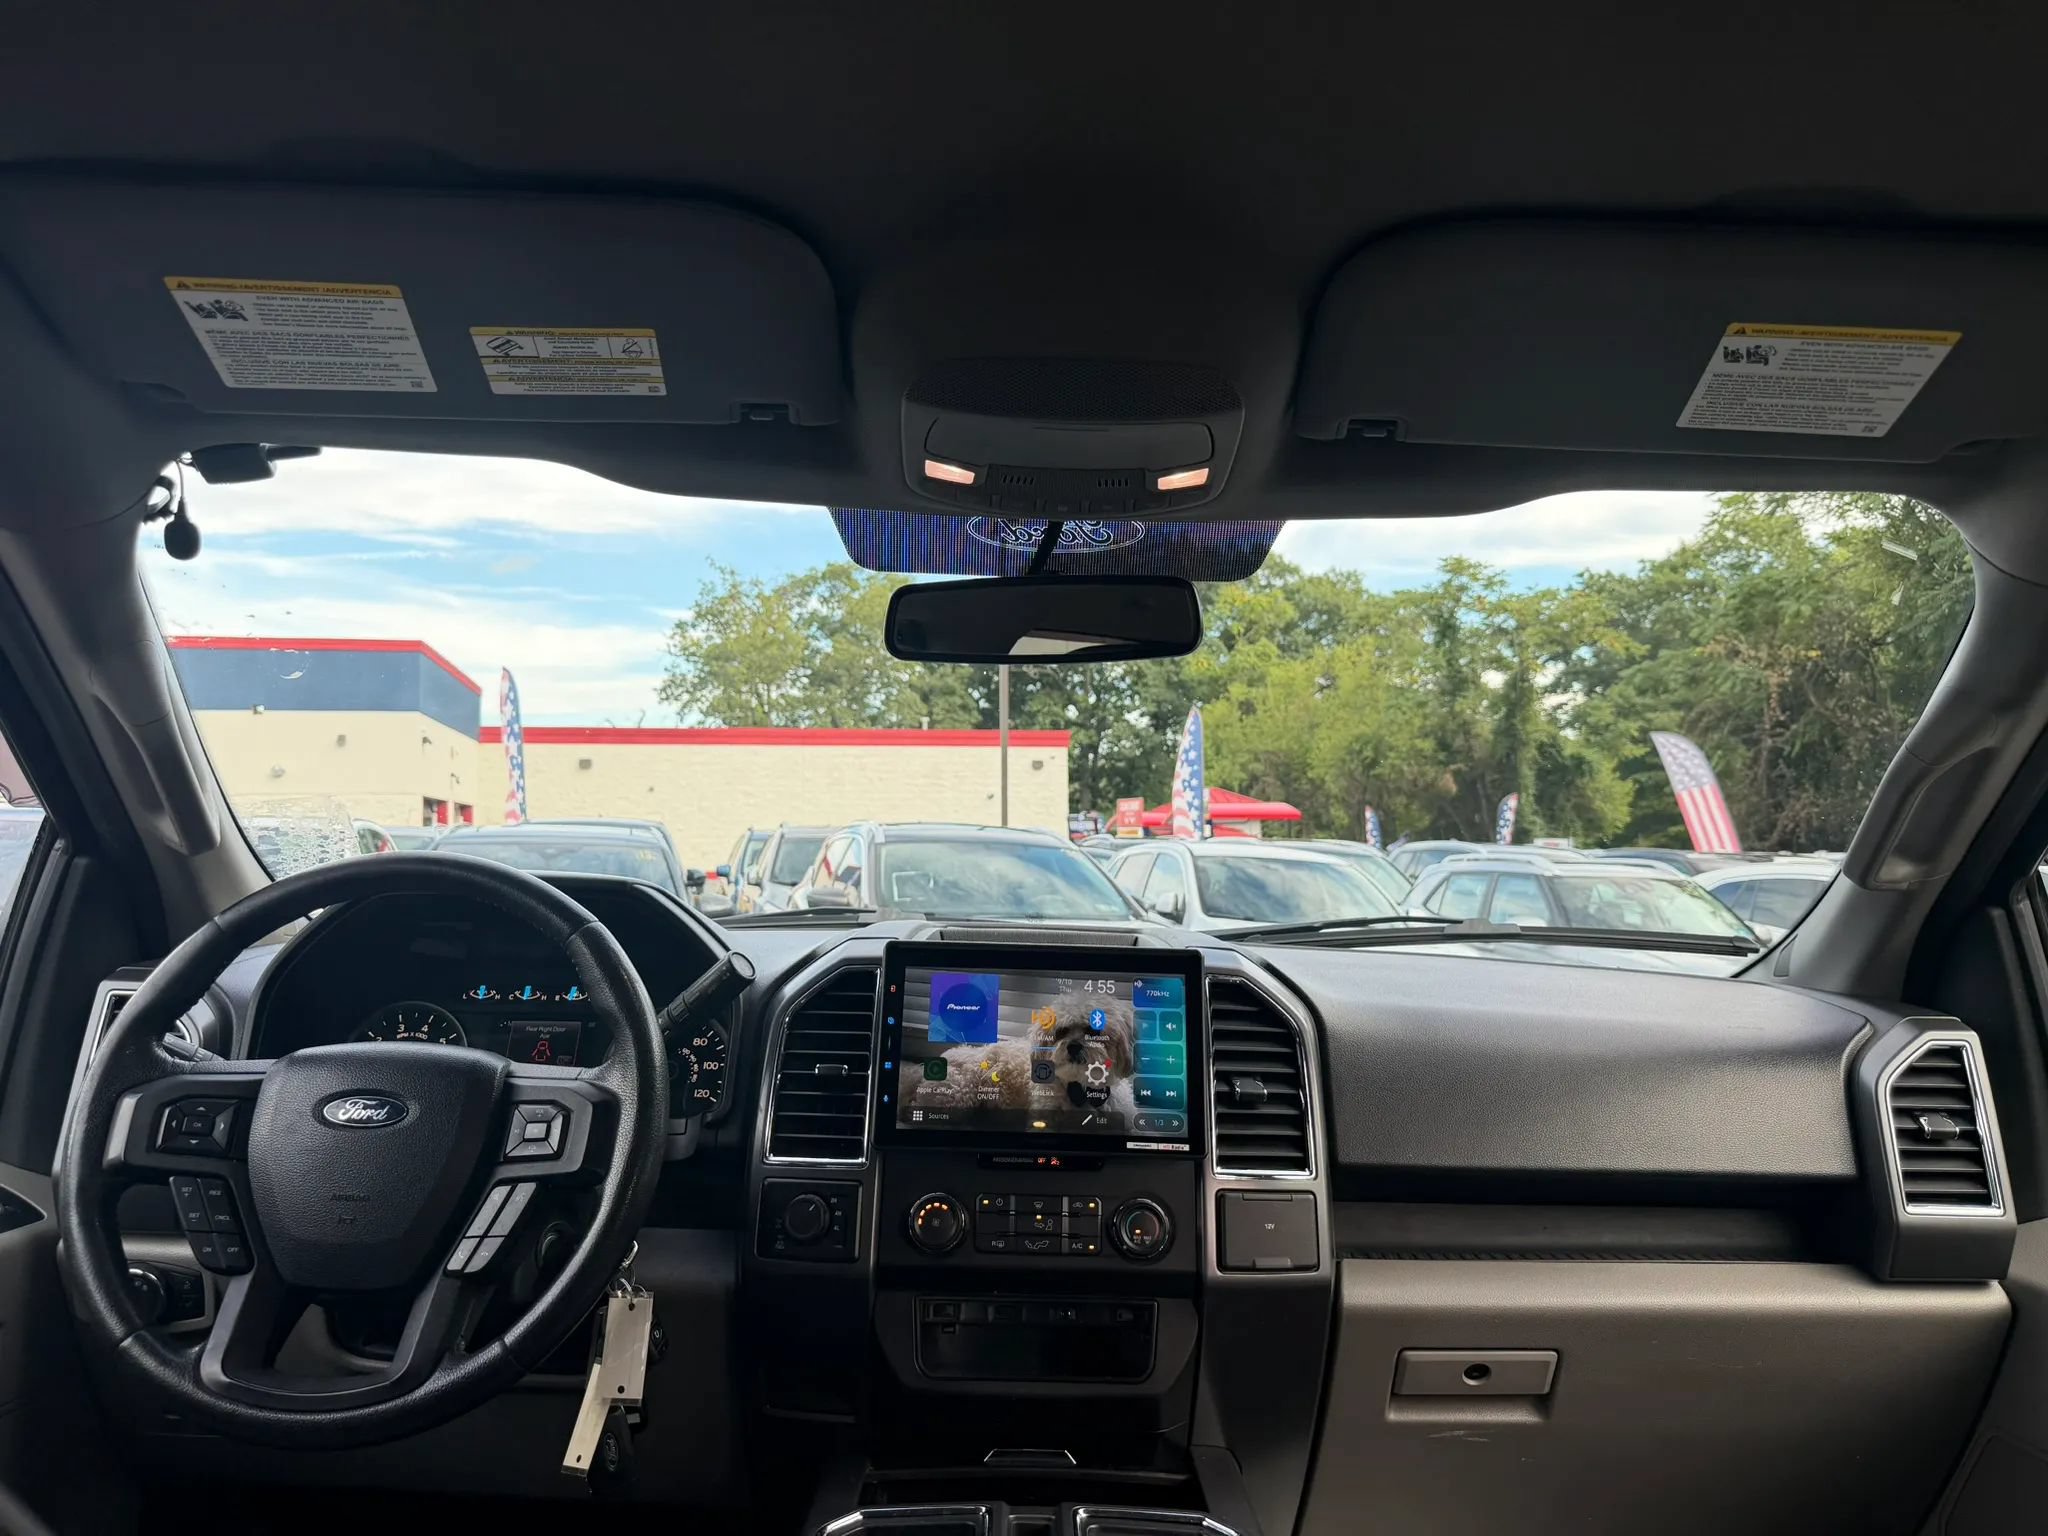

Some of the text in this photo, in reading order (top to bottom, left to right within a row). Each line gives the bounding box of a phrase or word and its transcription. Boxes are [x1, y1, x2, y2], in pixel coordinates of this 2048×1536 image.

[1146, 990, 1170, 998] 770kHz
[946, 1003, 980, 1011] Pioneer
[397, 1023, 428, 1033] 3 4
[692, 1038, 708, 1046] 80
[703, 1062, 719, 1070] 100
[694, 1089, 710, 1098] 120
[1086, 1090, 1108, 1100] Settings
[338, 1099, 391, 1120] Ford
[928, 1112, 949, 1120] Sources
[1096, 1116, 1108, 1124] Edit
